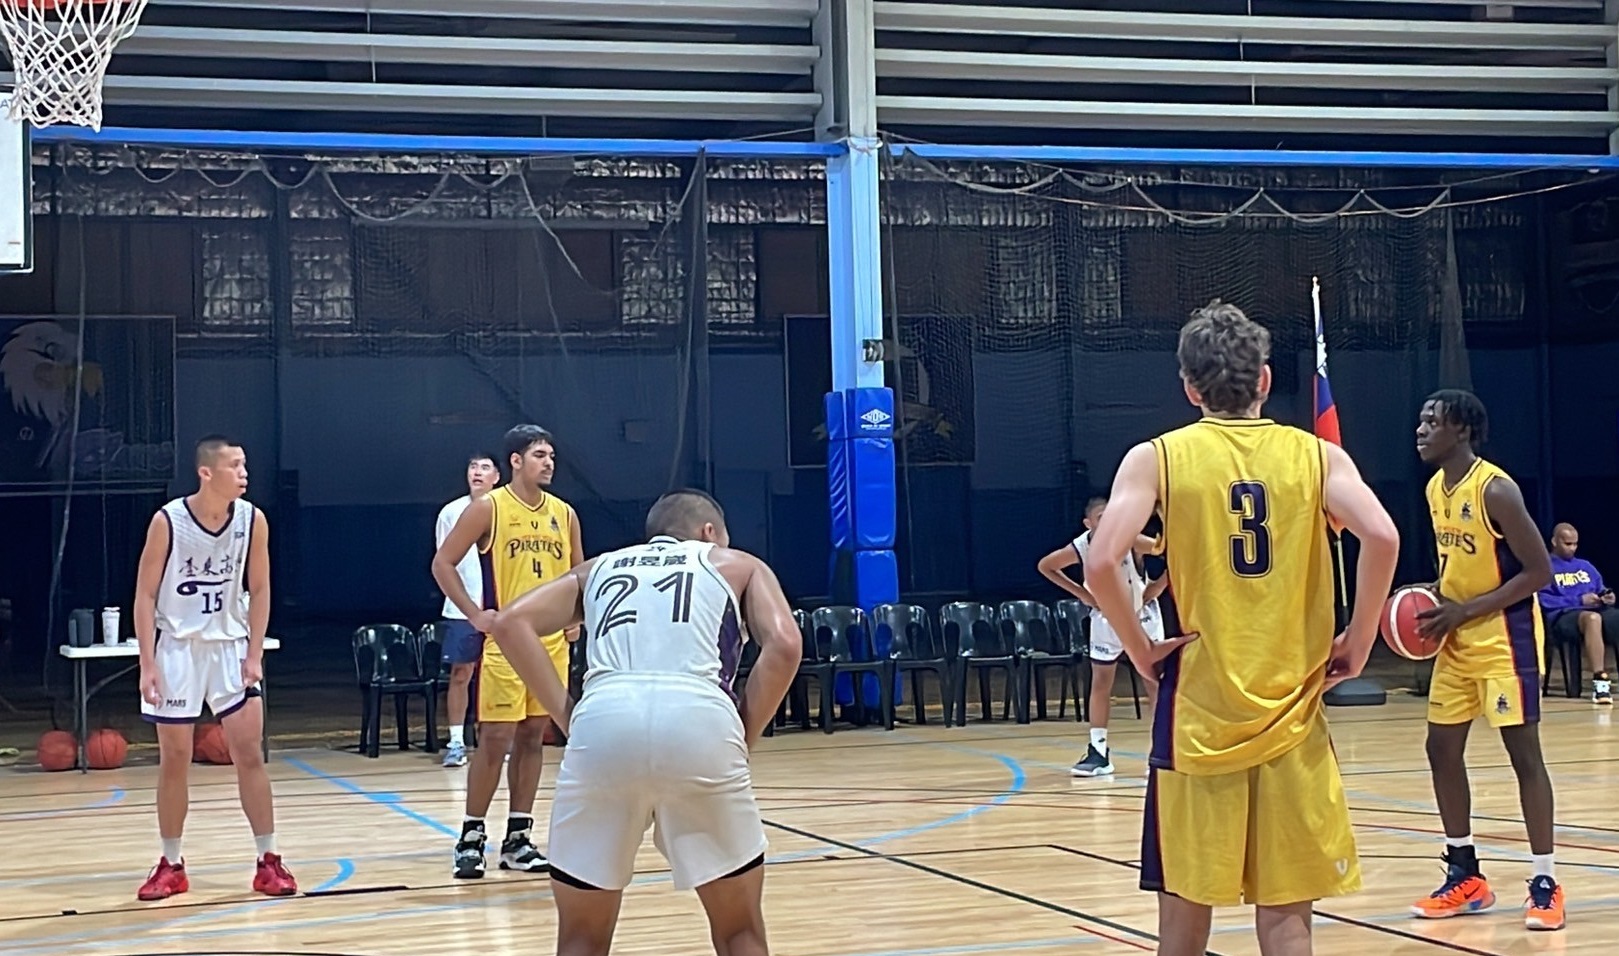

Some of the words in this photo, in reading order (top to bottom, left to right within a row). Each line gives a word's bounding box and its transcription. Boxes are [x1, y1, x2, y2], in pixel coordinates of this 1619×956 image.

[1229, 480, 1273, 578] 3
[506, 539, 563, 560] PIRATES
[532, 558, 542, 578] 4
[1440, 553, 1449, 577] 7
[201, 590, 223, 614] 15
[595, 571, 694, 640] 21
[166, 699, 187, 707] MARS
